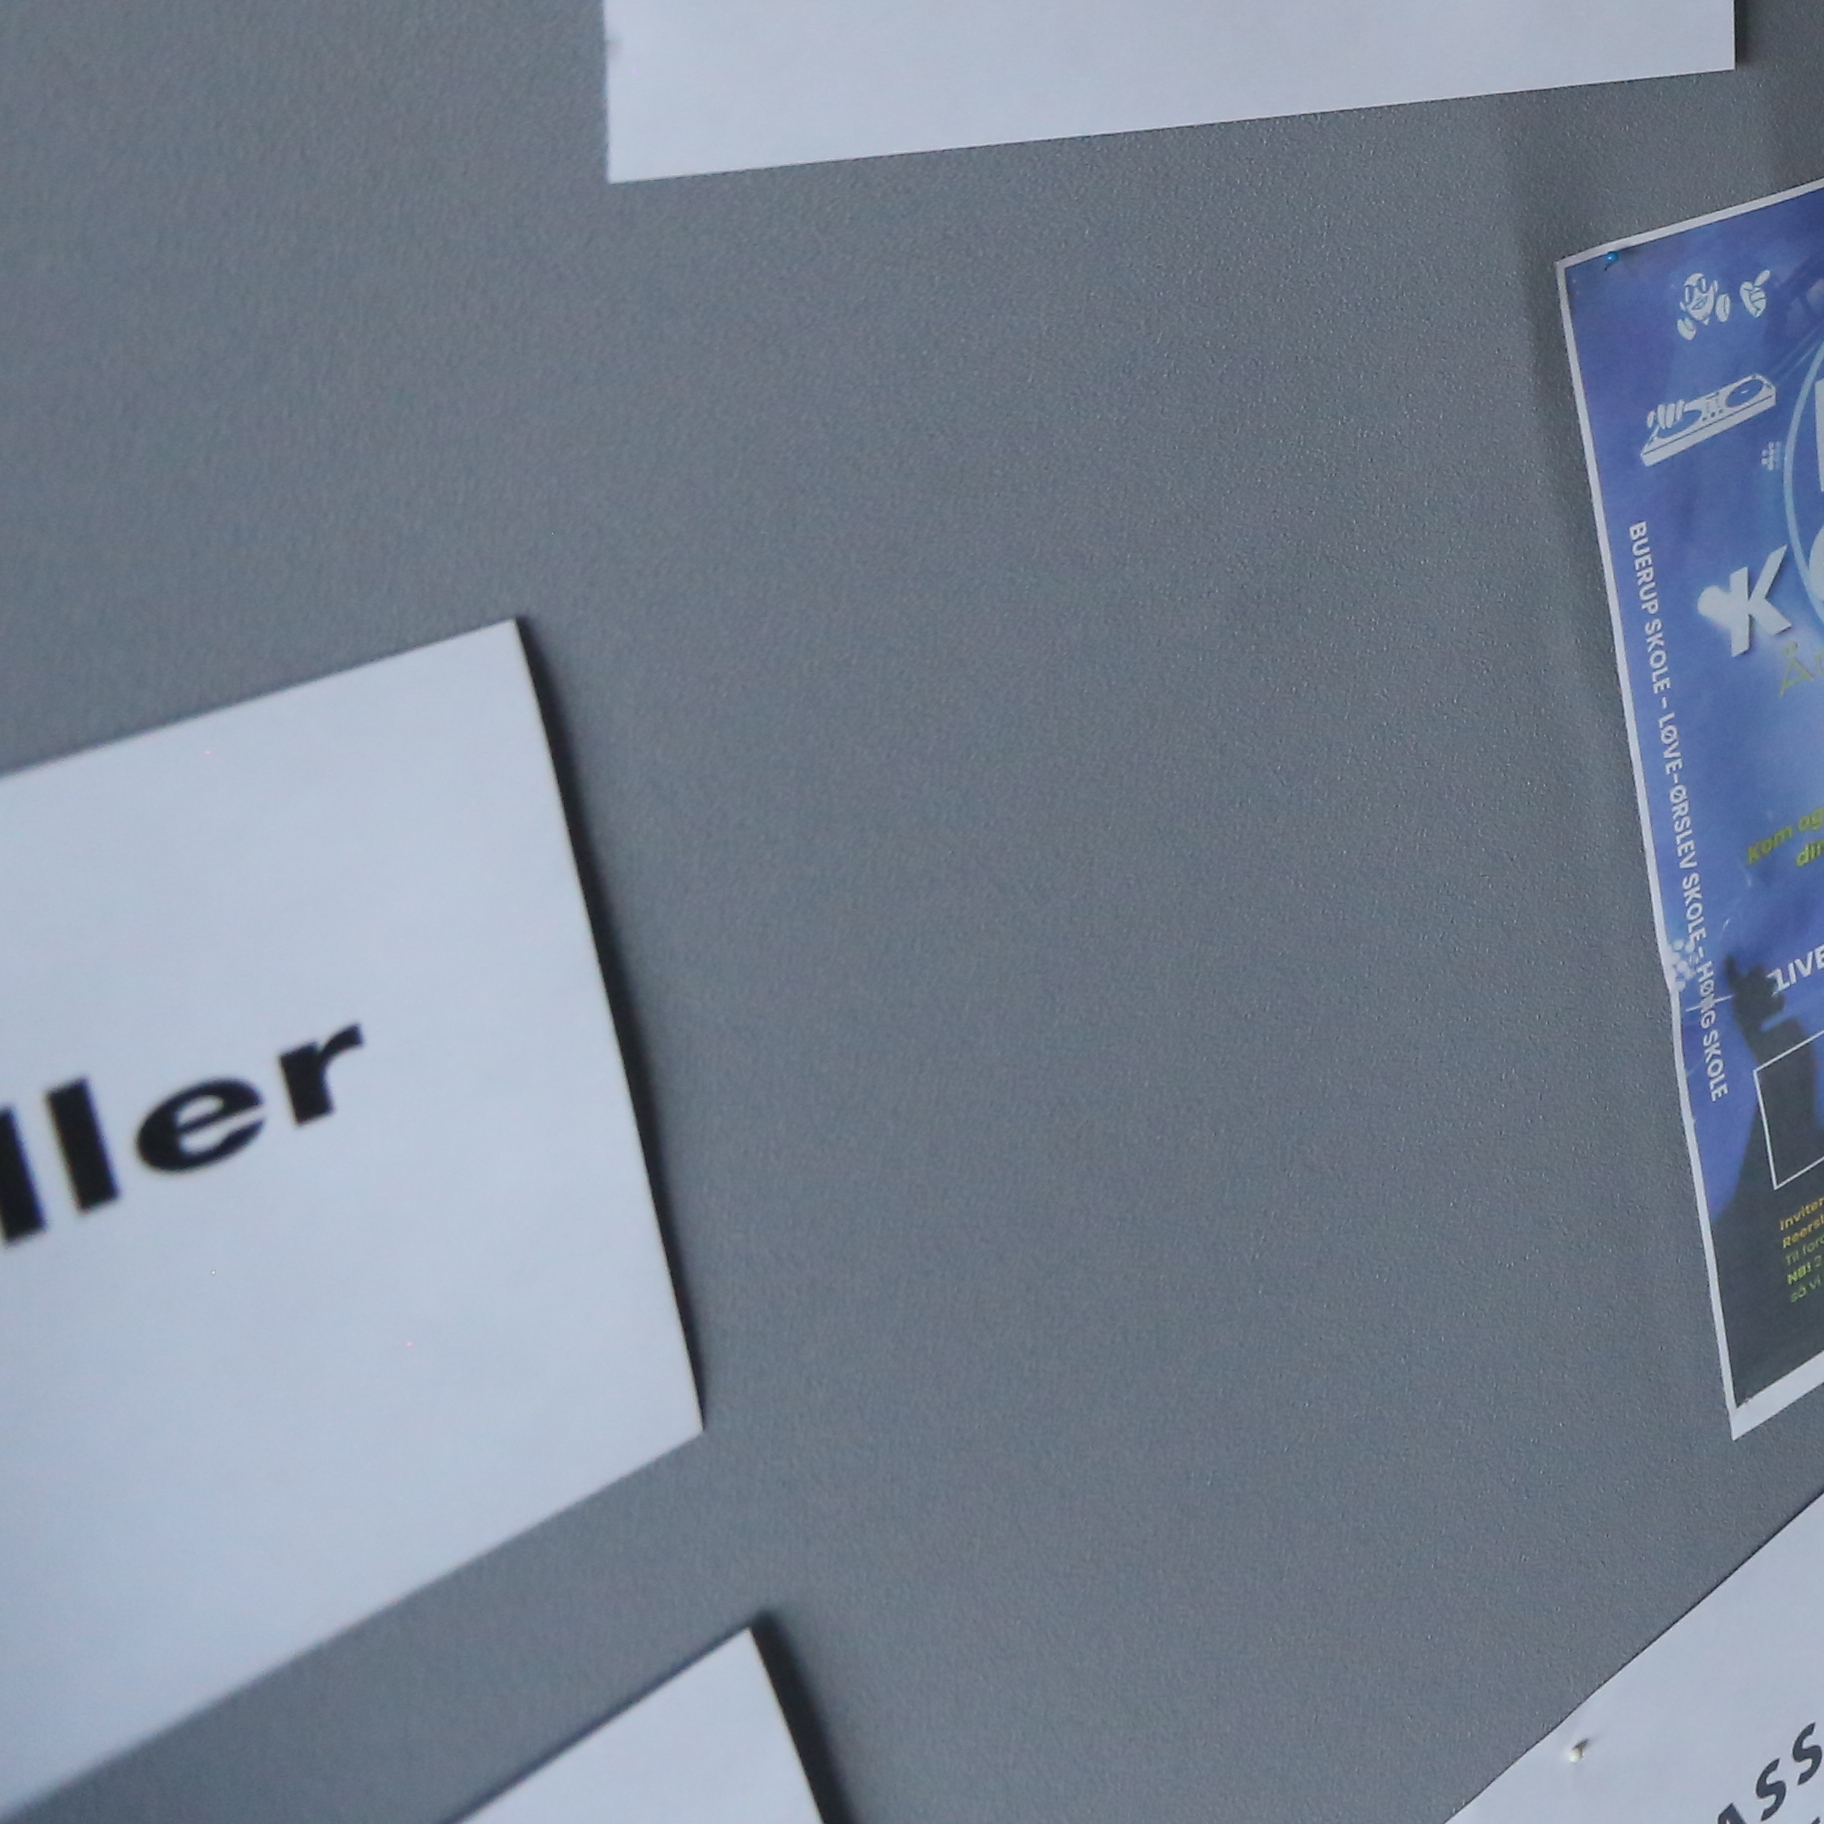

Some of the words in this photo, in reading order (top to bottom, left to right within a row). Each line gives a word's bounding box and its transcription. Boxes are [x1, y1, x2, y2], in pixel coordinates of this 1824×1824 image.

[1628, 519, 1661, 616] BUERUP
[1643, 617, 1673, 696] SKOLE
[1681, 871, 1708, 944] SKOLE
[1702, 1028, 1730, 1103] SKOLE
